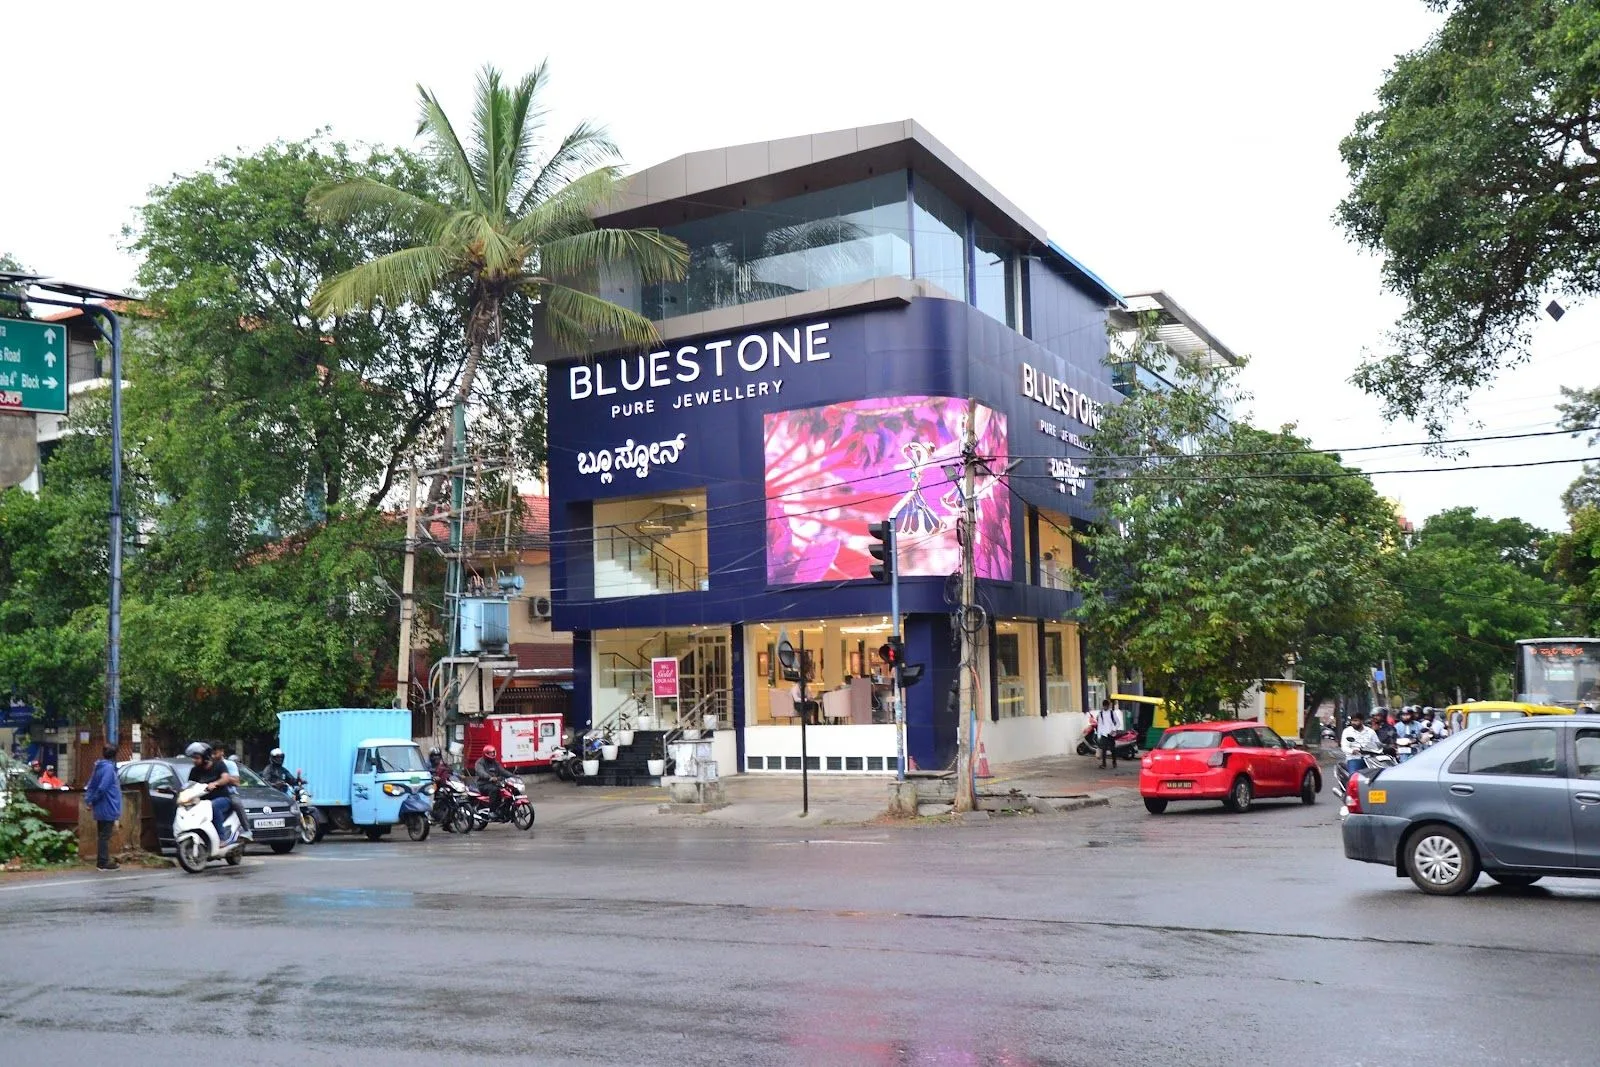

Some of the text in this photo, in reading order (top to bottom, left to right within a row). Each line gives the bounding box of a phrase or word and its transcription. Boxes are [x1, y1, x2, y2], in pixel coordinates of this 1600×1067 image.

[4, 347, 21, 363] Road
[570, 322, 831, 400] BLUESTONE
[22, 373, 40, 389] Block
[611, 380, 783, 418] PURE JEWELLERY
[1040, 419, 1056, 437] PURE
